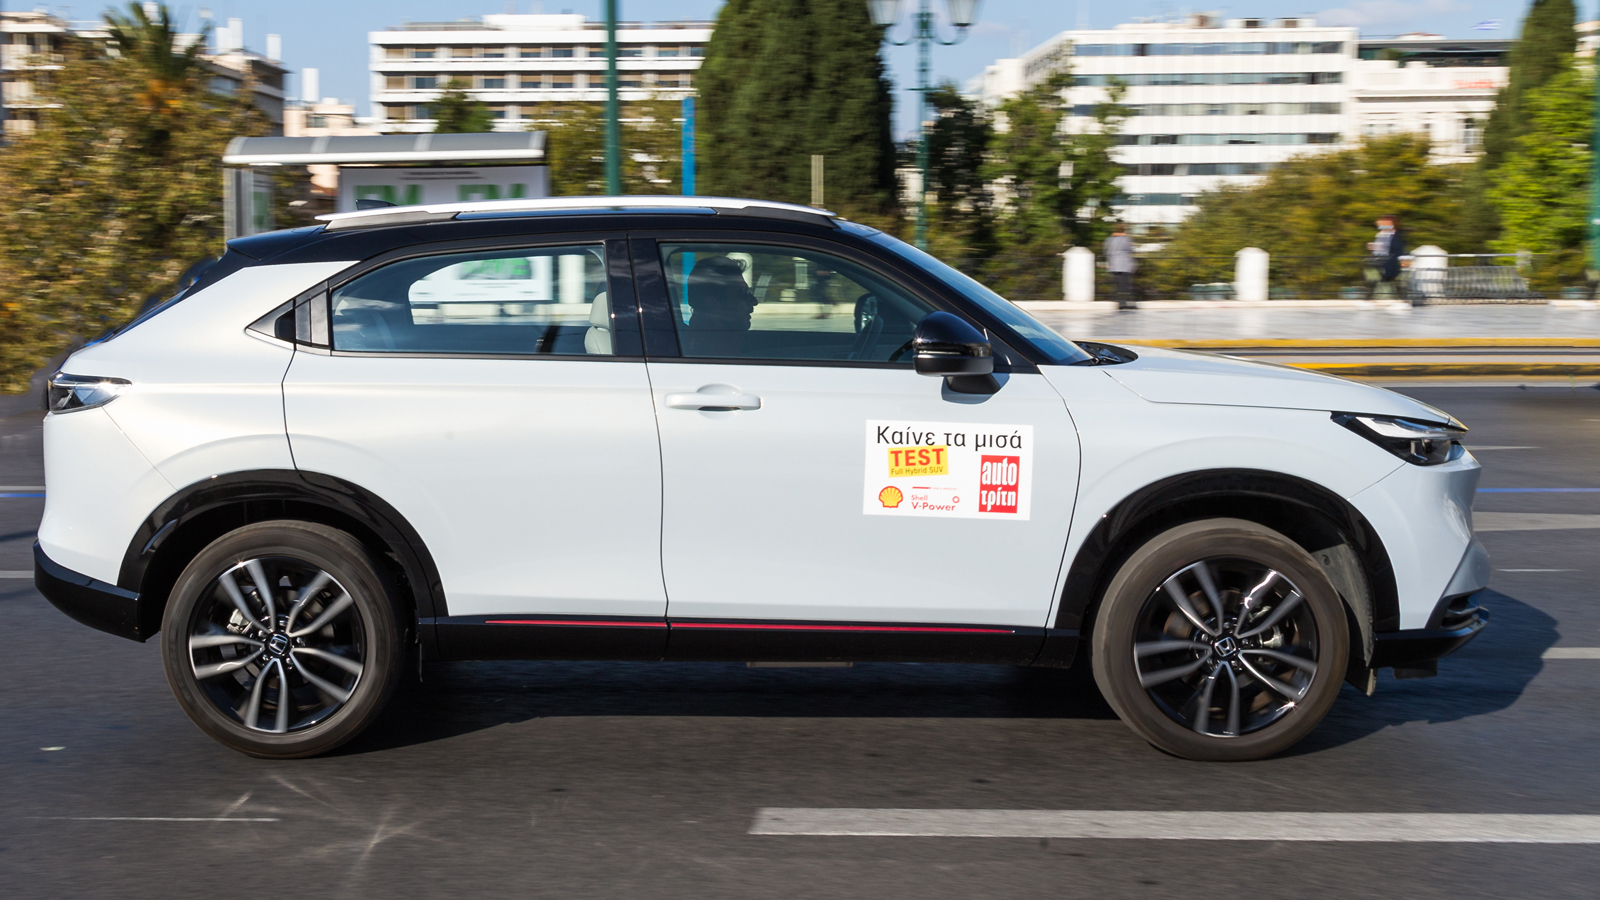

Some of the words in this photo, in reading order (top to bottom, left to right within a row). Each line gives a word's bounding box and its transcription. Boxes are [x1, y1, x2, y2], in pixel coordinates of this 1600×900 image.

[876, 425, 936, 446] Καίνε
[943, 432, 966, 447] τα
[975, 429, 1022, 451] μισά
[890, 448, 944, 467] TEST
[890, 467, 904, 475] Full
[905, 466, 927, 476] Hybrid
[929, 465, 944, 474] SUV
[981, 457, 1018, 486] auto
[911, 501, 956, 511] V-Power
[980, 486, 1017, 512] τρίτη
